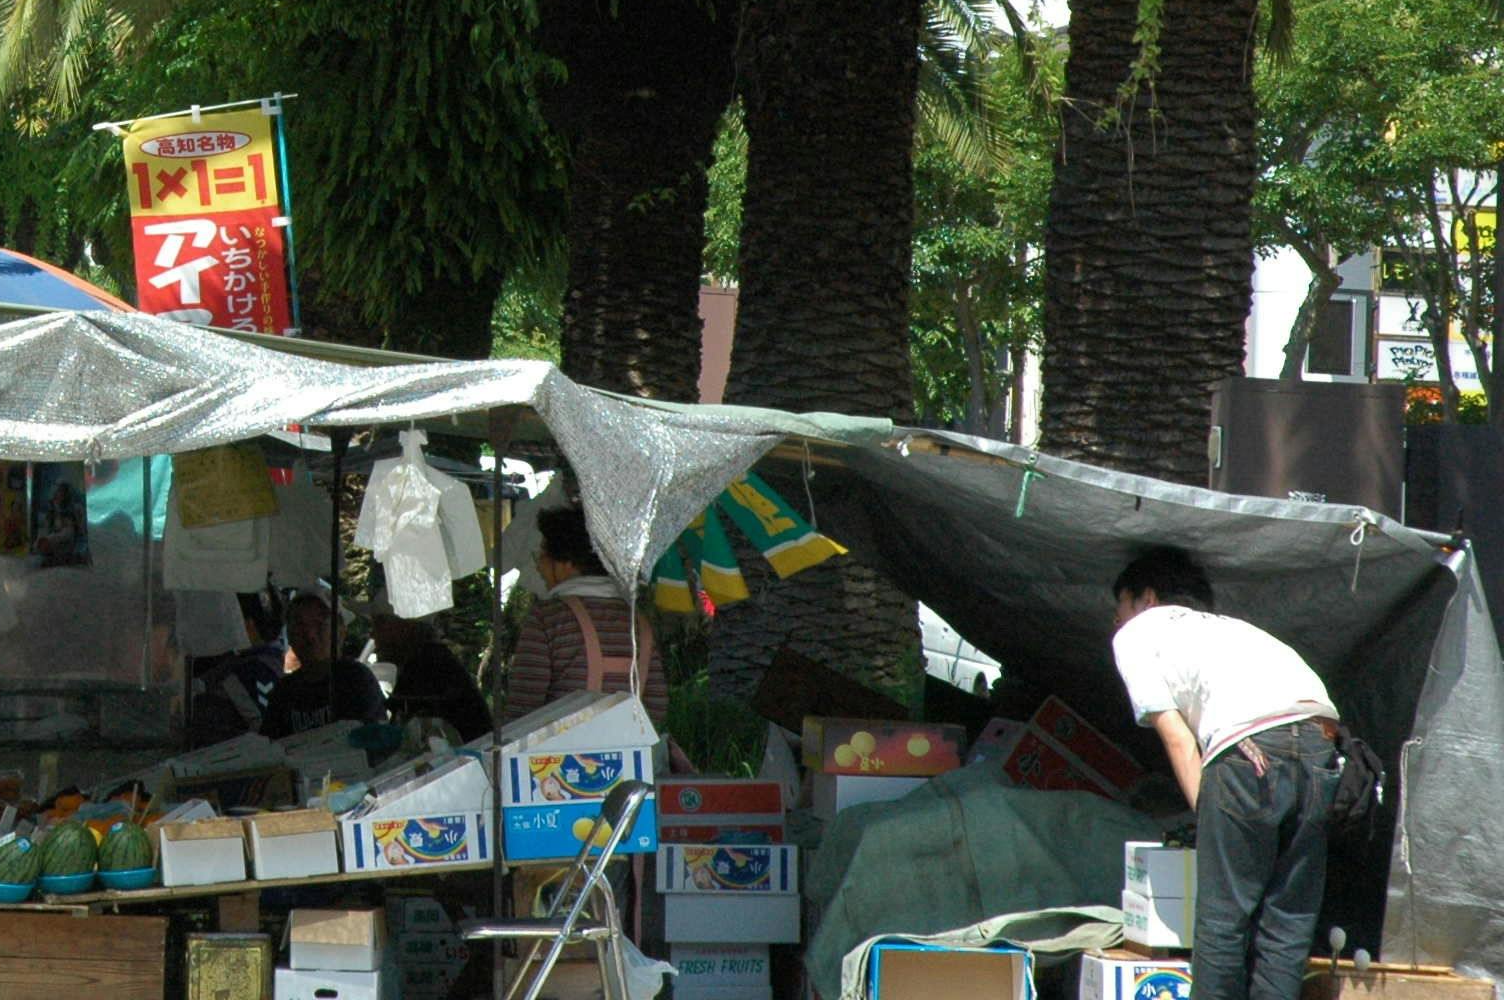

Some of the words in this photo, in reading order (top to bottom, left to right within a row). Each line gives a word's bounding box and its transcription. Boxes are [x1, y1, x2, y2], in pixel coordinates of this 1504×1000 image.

[157, 134, 236, 156] 高知名物
[679, 959, 716, 975] FRESH
[721, 958, 764, 975] FRUITS
